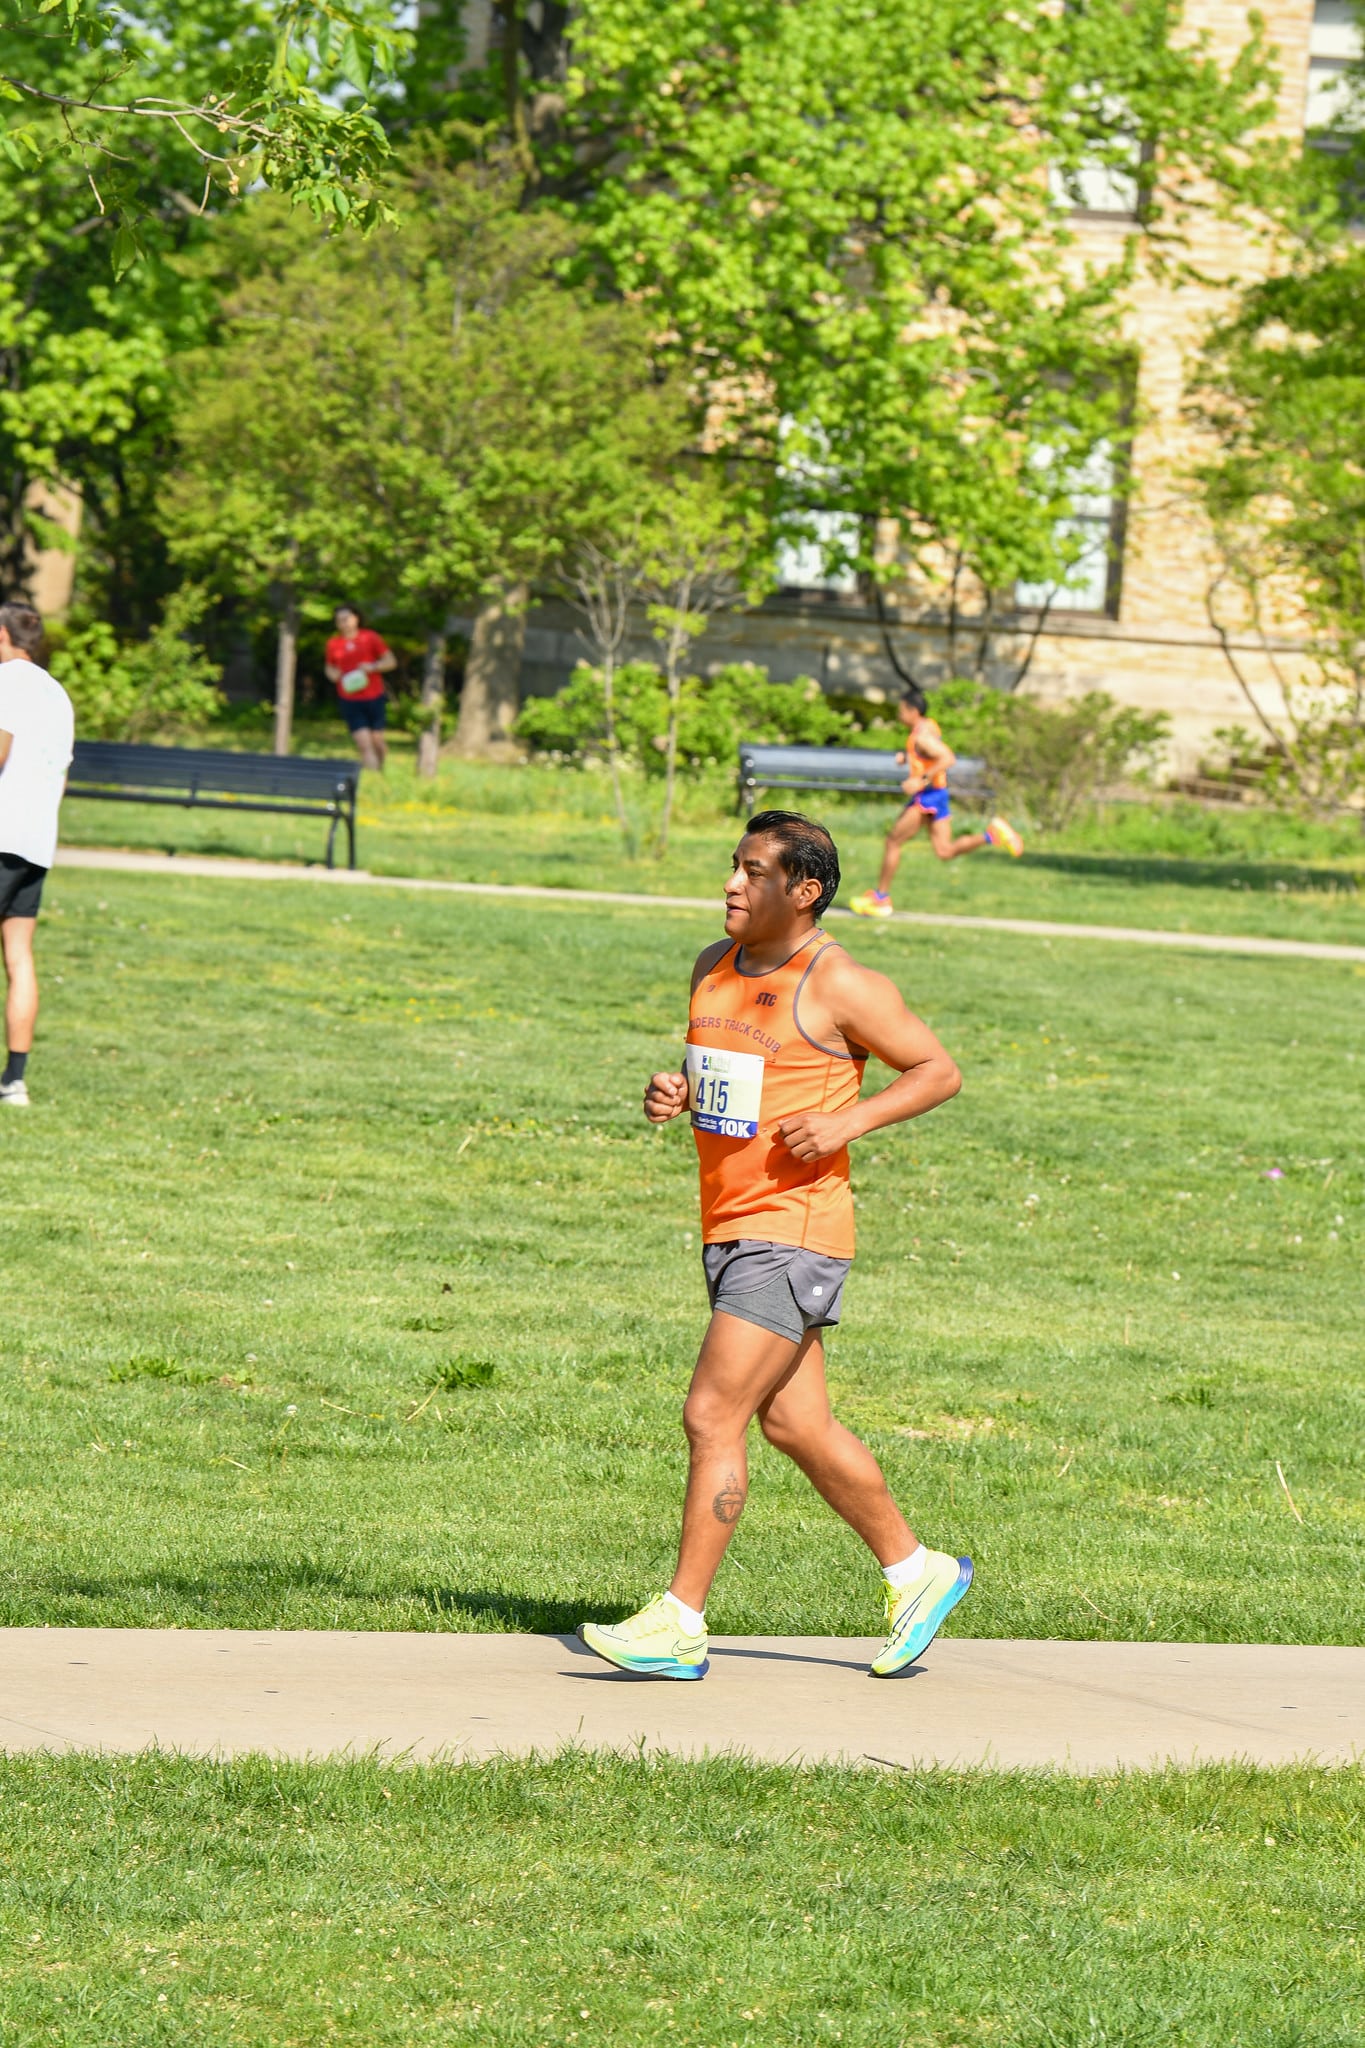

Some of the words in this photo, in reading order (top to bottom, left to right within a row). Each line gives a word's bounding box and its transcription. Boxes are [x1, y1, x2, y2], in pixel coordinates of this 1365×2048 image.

[755, 992, 777, 1007] STC
[725, 1019, 752, 1036] TRACK
[752, 1029, 782, 1053] CLUB
[696, 1077, 729, 1114] 415
[718, 1119, 751, 1138] 10K
